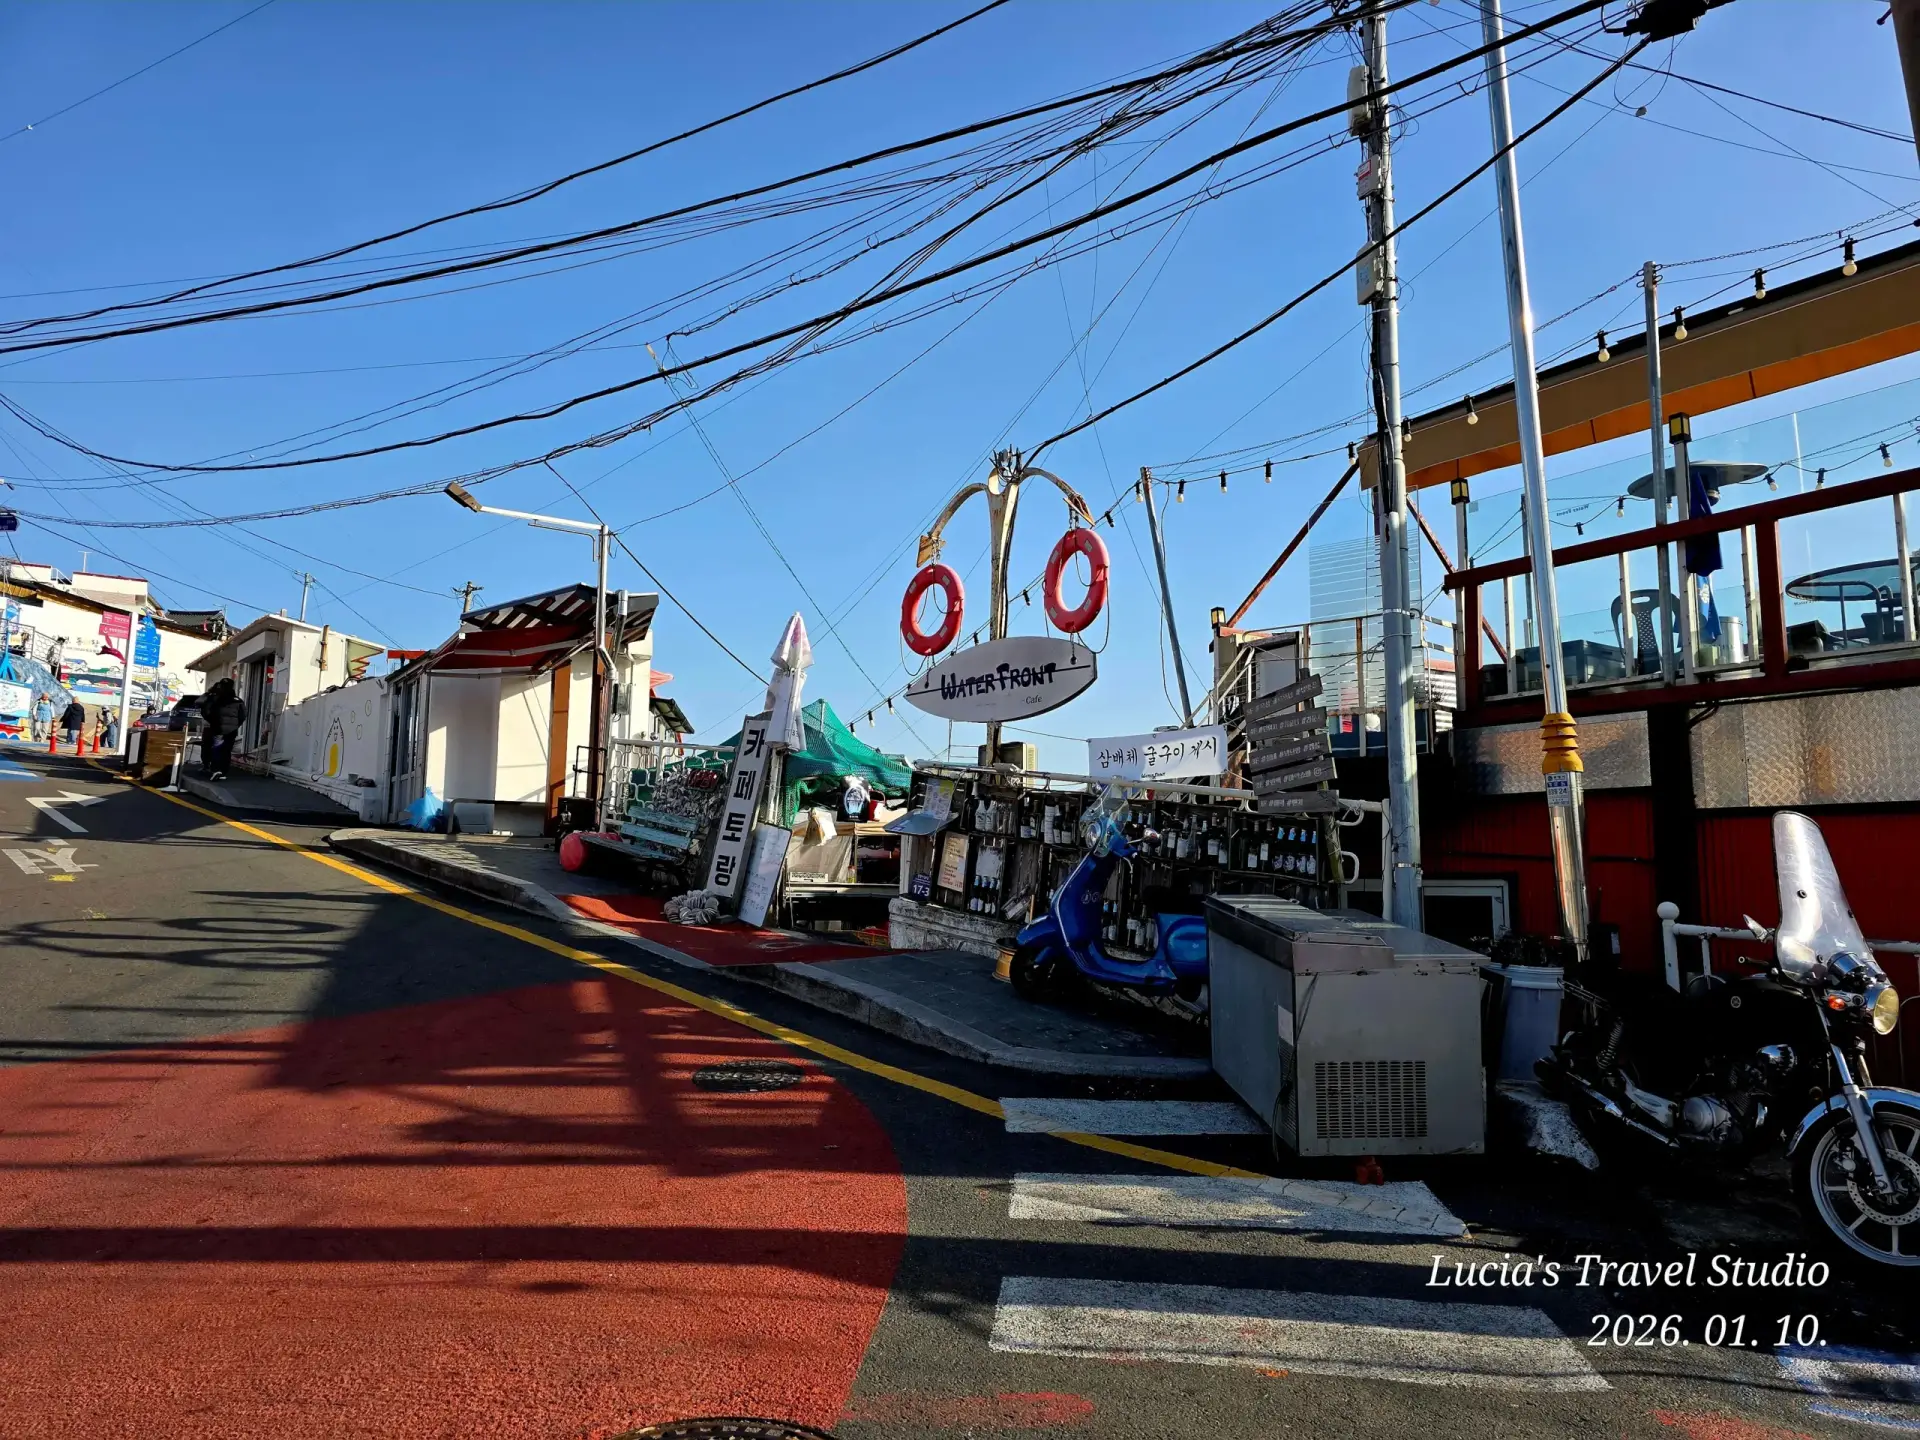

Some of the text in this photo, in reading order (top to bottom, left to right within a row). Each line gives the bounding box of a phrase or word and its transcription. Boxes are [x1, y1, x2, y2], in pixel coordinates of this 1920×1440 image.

[1096, 747, 1138, 769] 삼배체
[1144, 742, 1185, 767] 굴구이
[714, 728, 766, 888] 카페토랑
[913, 884, 930, 897] 17-3
